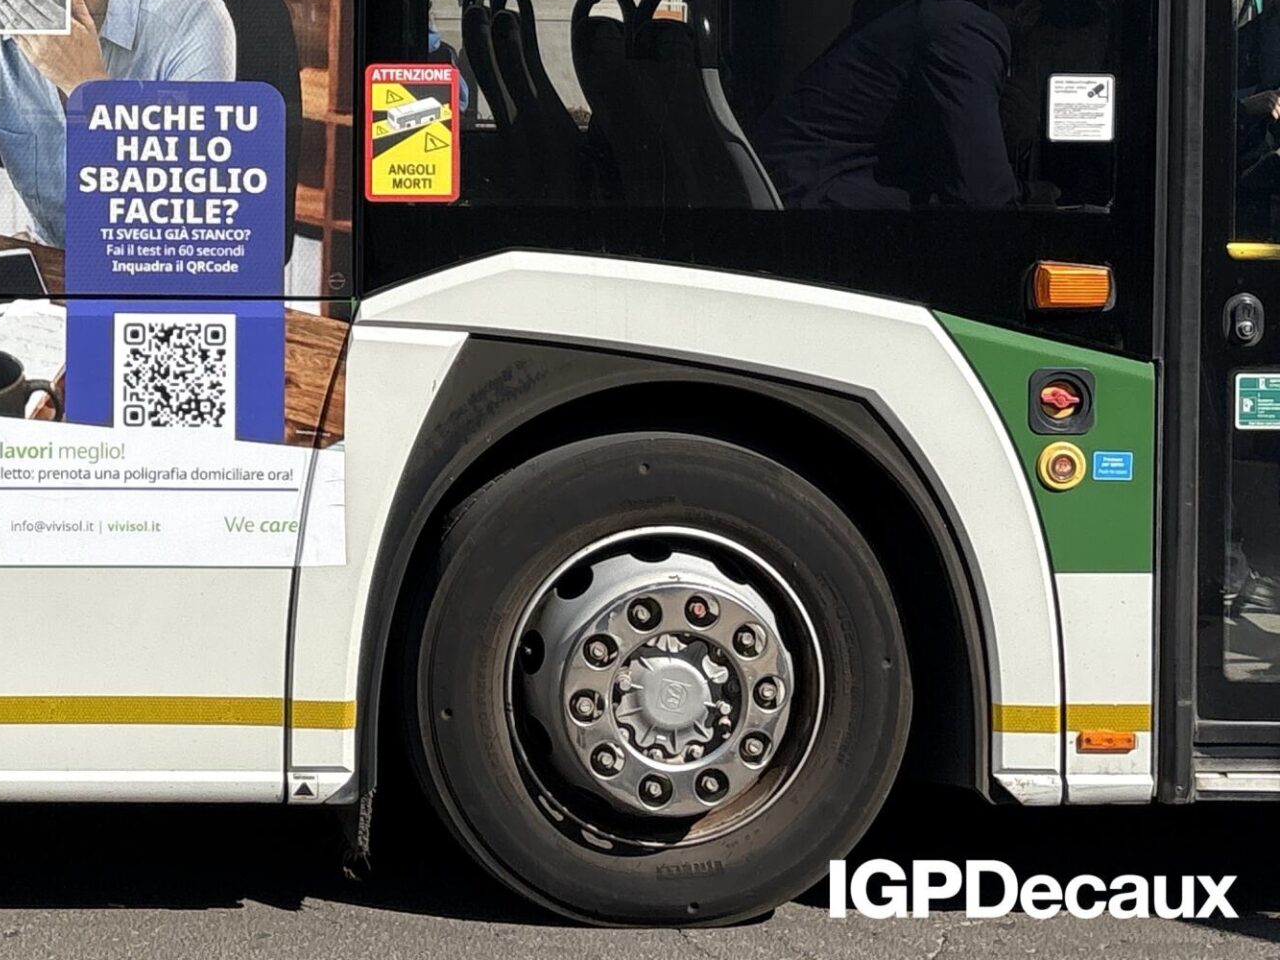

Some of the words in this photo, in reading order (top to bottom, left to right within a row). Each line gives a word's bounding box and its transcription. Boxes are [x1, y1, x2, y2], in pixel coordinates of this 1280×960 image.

[372, 69, 452, 81] ATTENZIONE
[88, 104, 206, 131] ANCHE
[214, 105, 258, 131] TU
[116, 136, 179, 161] HAI
[189, 136, 232, 162] LO
[388, 164, 436, 175] ANGOLI
[79, 166, 268, 194] SBADIGLIO
[392, 178, 432, 189] MORTI
[109, 198, 239, 224] FACILE?
[100, 229, 113, 240] TI
[116, 229, 162, 240] SVEGLI
[165, 226, 189, 240] GIÀ
[191, 229, 251, 241] STANCO?
[106, 244, 124, 256] Fai
[127, 244, 134, 256] il
[137, 246, 161, 256] test
[164, 245, 176, 256] in
[178, 245, 194, 256] 60
[196, 244, 245, 257] secondi
[112, 260, 173, 274] Inquadra
[176, 260, 183, 272] il
[186, 260, 239, 274] QRCode
[0, 442, 53, 459] lavori
[59, 442, 126, 464] meglio!
[1, 468, 35, 480] letto:
[38, 469, 91, 483] prenota
[94, 471, 120, 481] una
[124, 468, 187, 484] poligrafia
[191, 468, 264, 481] domiciliare
[268, 469, 294, 481] ora!
[10, 520, 94, 533] info@vivisol.it
[107, 520, 161, 533] vivisol.it
[224, 516, 255, 533] We
